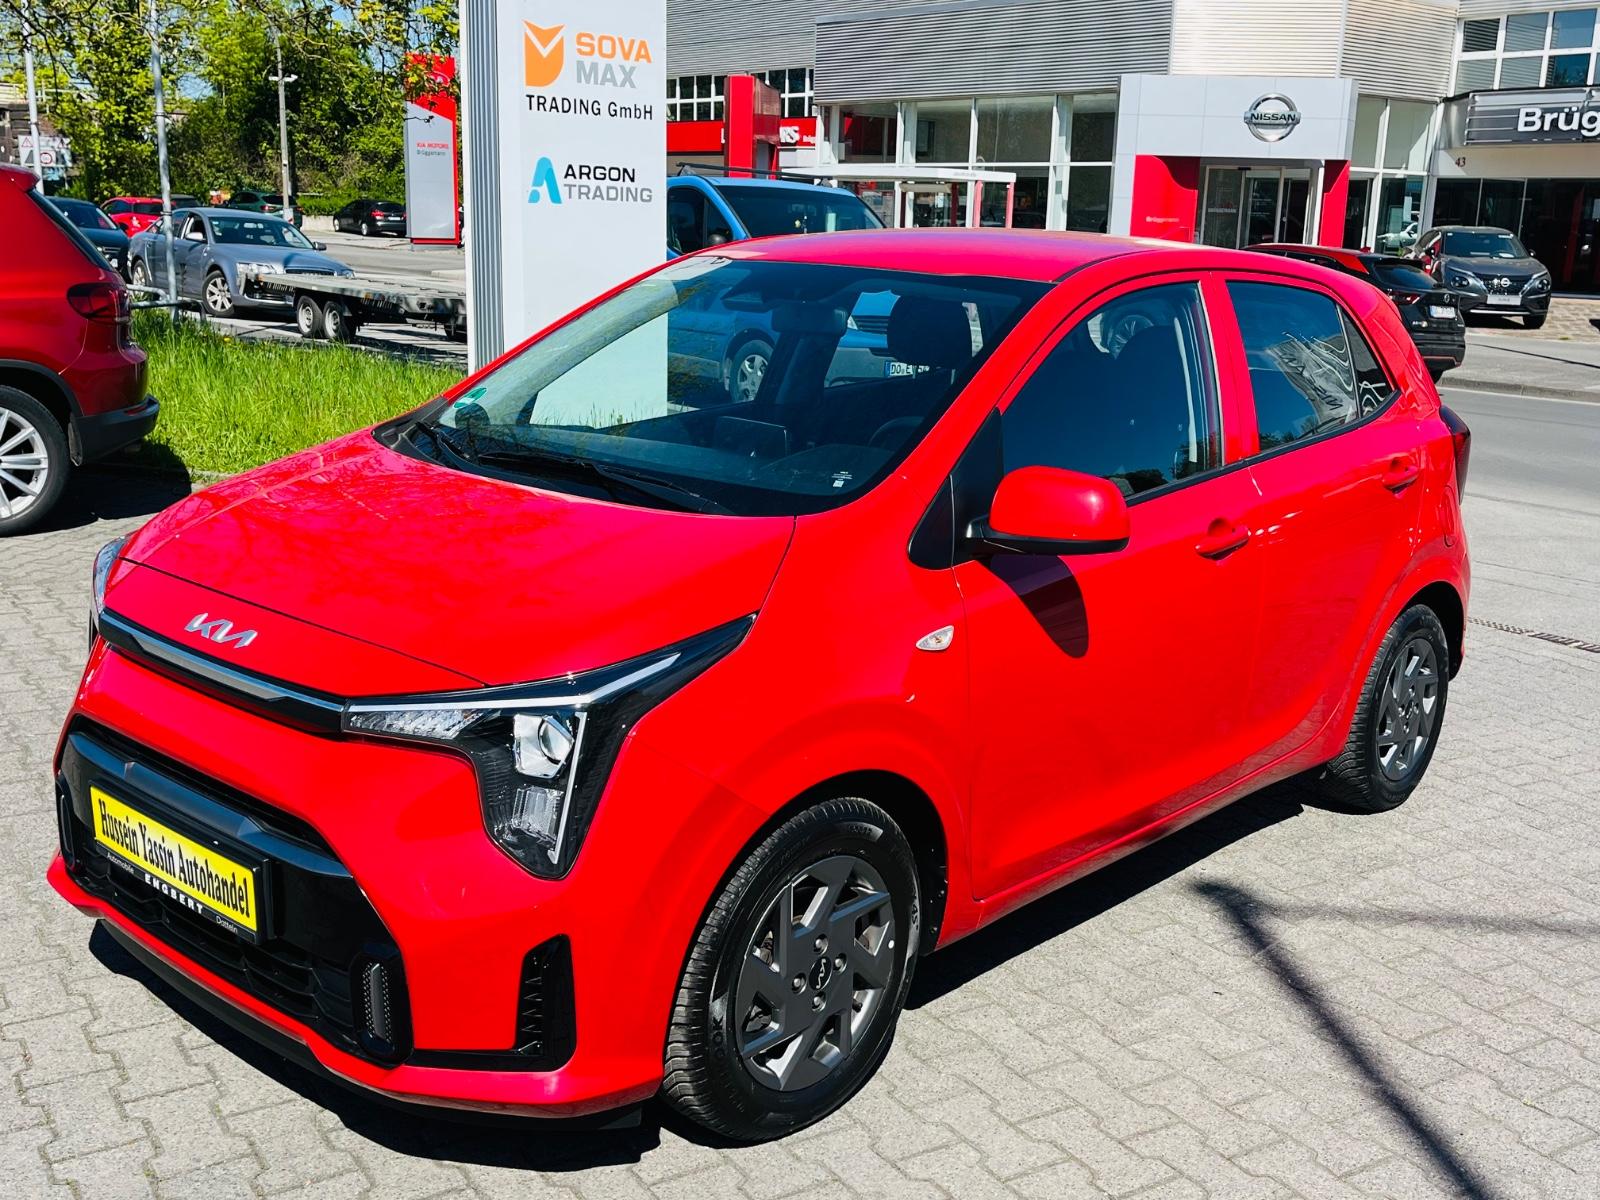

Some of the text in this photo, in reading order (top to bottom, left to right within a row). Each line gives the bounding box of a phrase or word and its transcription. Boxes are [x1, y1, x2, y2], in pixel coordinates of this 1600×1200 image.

[575, 32, 652, 64] SOVA
[575, 60, 637, 88] MAX
[525, 94, 653, 120] TRADING GmbH
[1250, 112, 1296, 122] NISSAN
[563, 164, 635, 183] ARGON
[1455, 157, 1466, 167] 43
[563, 184, 653, 203] TRADING
[184, 612, 258, 649] KIA
[98, 798, 250, 918] Hussein Yassin Autohandel
[144, 873, 204, 914] ENGBERT
